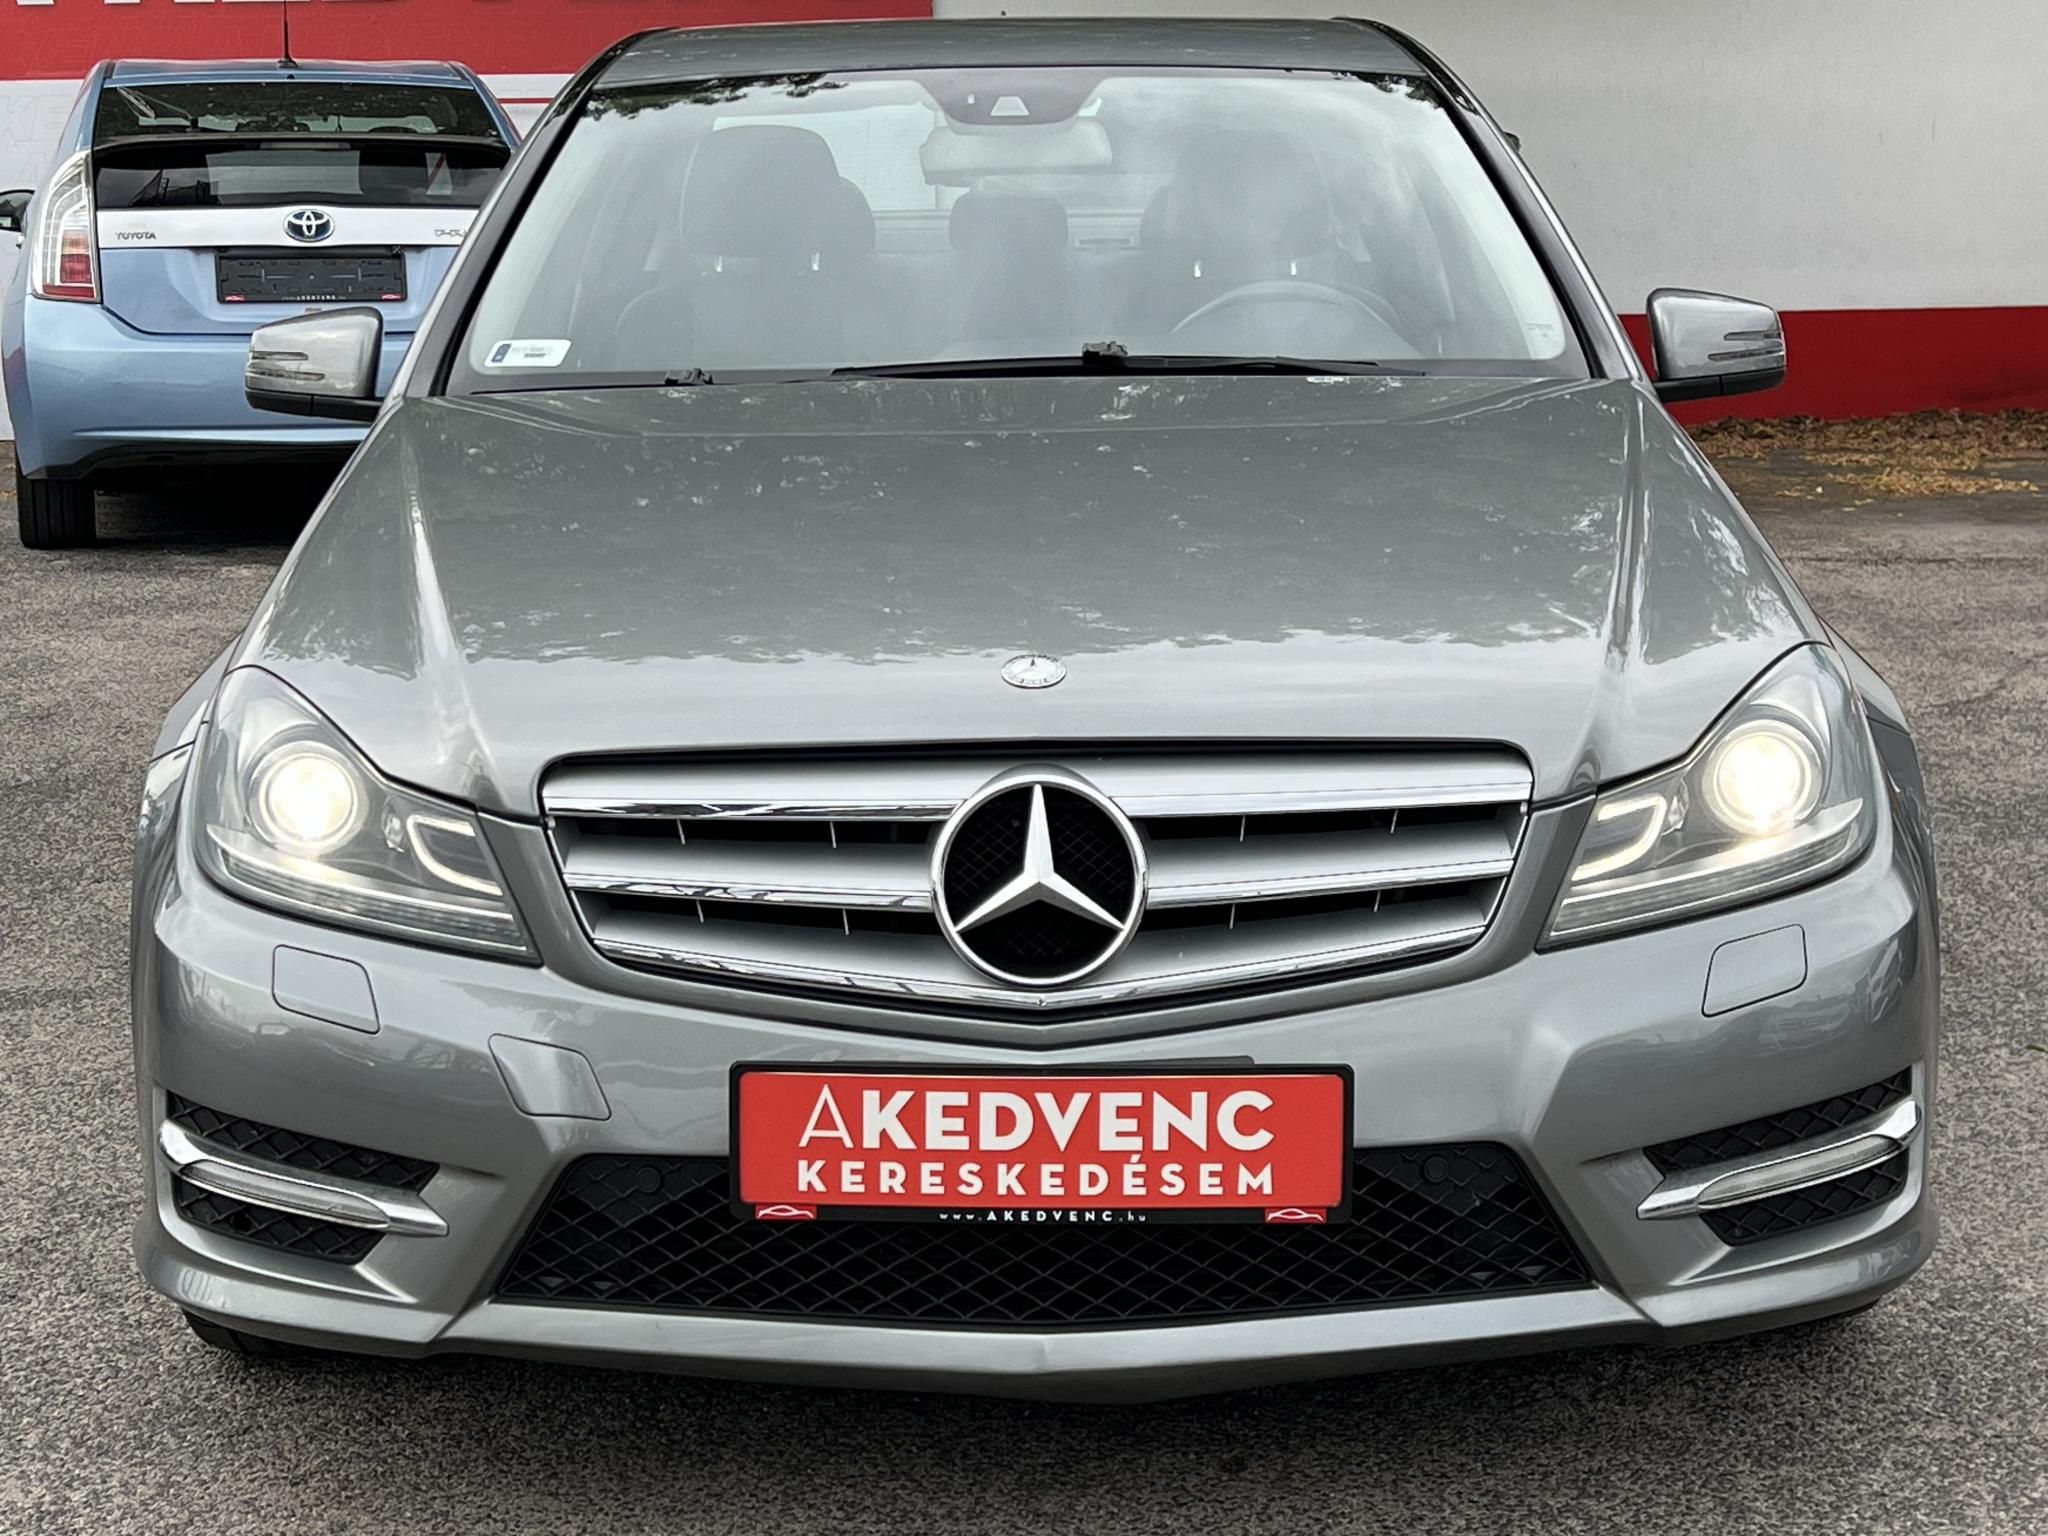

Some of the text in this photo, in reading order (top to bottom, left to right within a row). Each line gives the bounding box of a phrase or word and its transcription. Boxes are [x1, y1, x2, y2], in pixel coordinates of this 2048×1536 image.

[115, 231, 157, 240] TOYOTA
[798, 1083, 1275, 1152] AKEDVENC
[797, 1154, 1274, 1196] KERESKEDÉSEM
[939, 1209, 1147, 1222] www.AKEDVENC.hu
